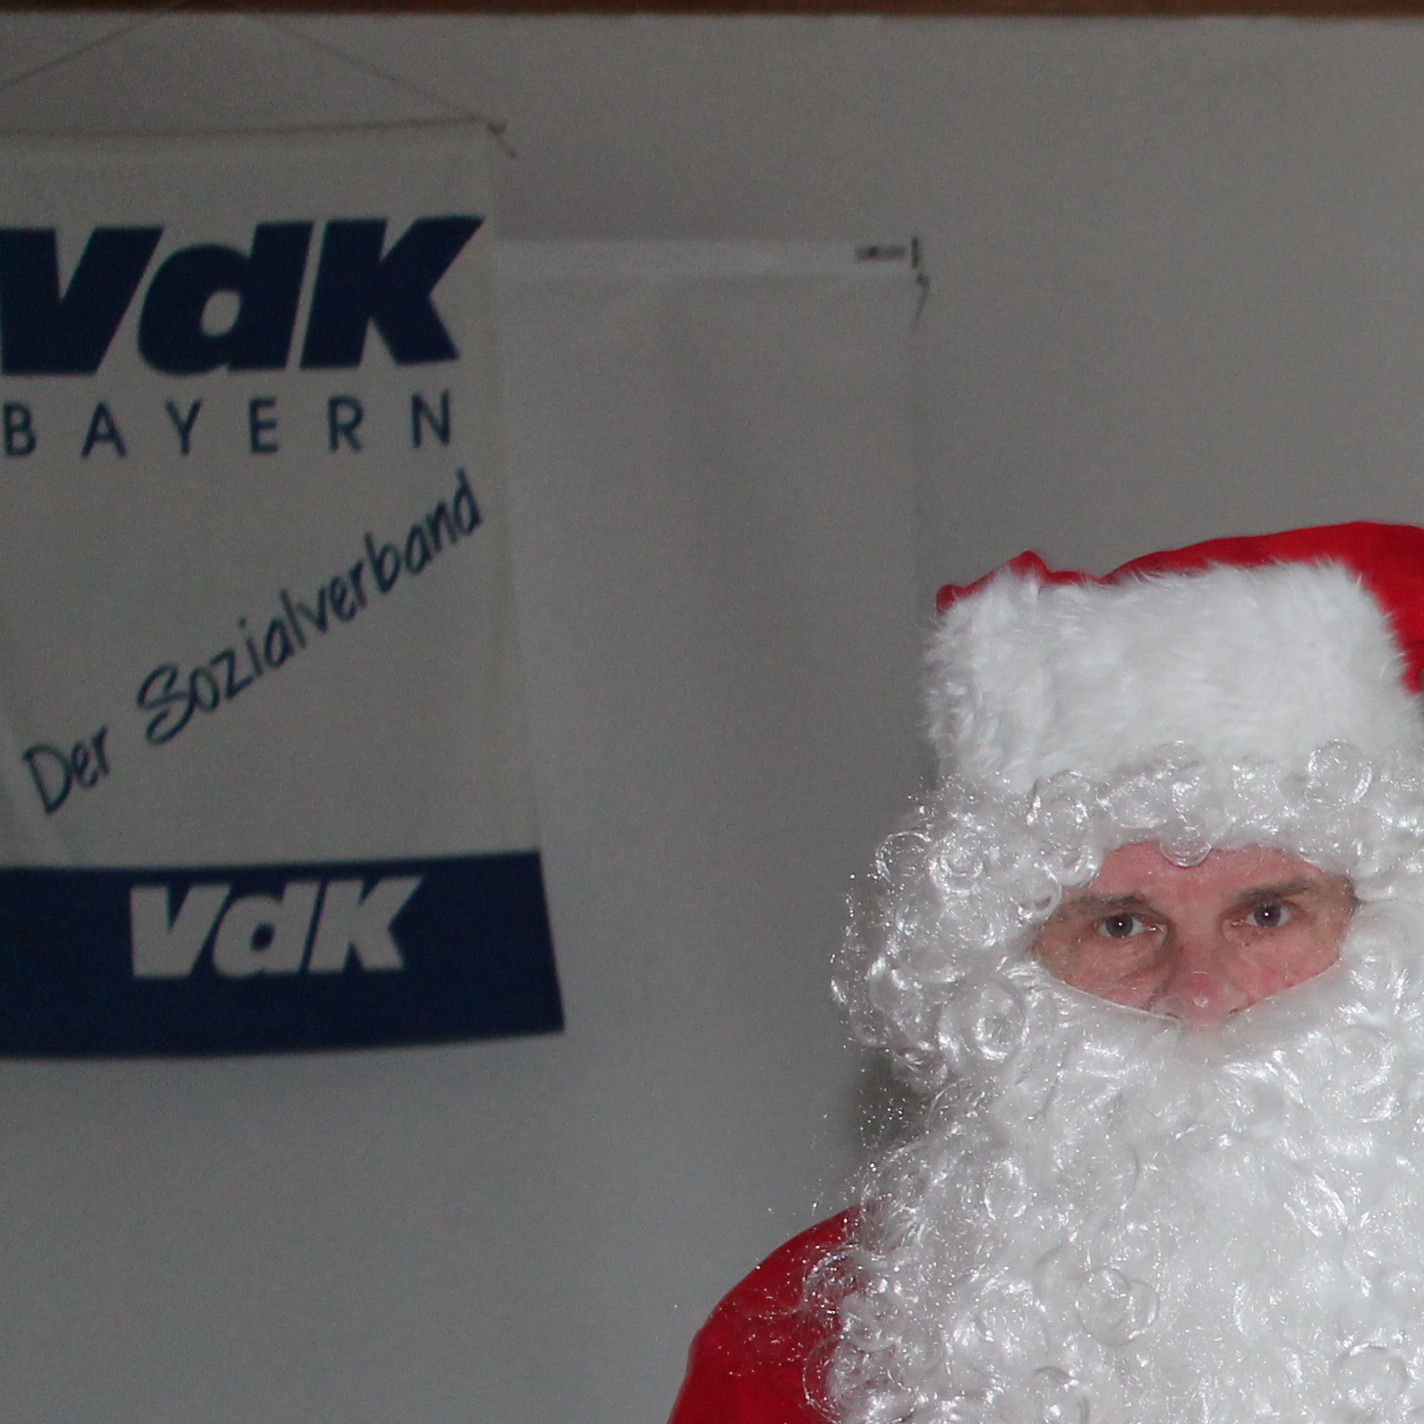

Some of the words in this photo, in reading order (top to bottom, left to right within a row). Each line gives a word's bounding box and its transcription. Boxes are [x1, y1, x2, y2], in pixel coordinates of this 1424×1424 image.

[0, 213, 485, 378] VdK
[1, 390, 452, 459] BAYERN
[21, 726, 109, 815] Der
[136, 468, 482, 747] Sozialverband
[129, 875, 422, 979] VdK
